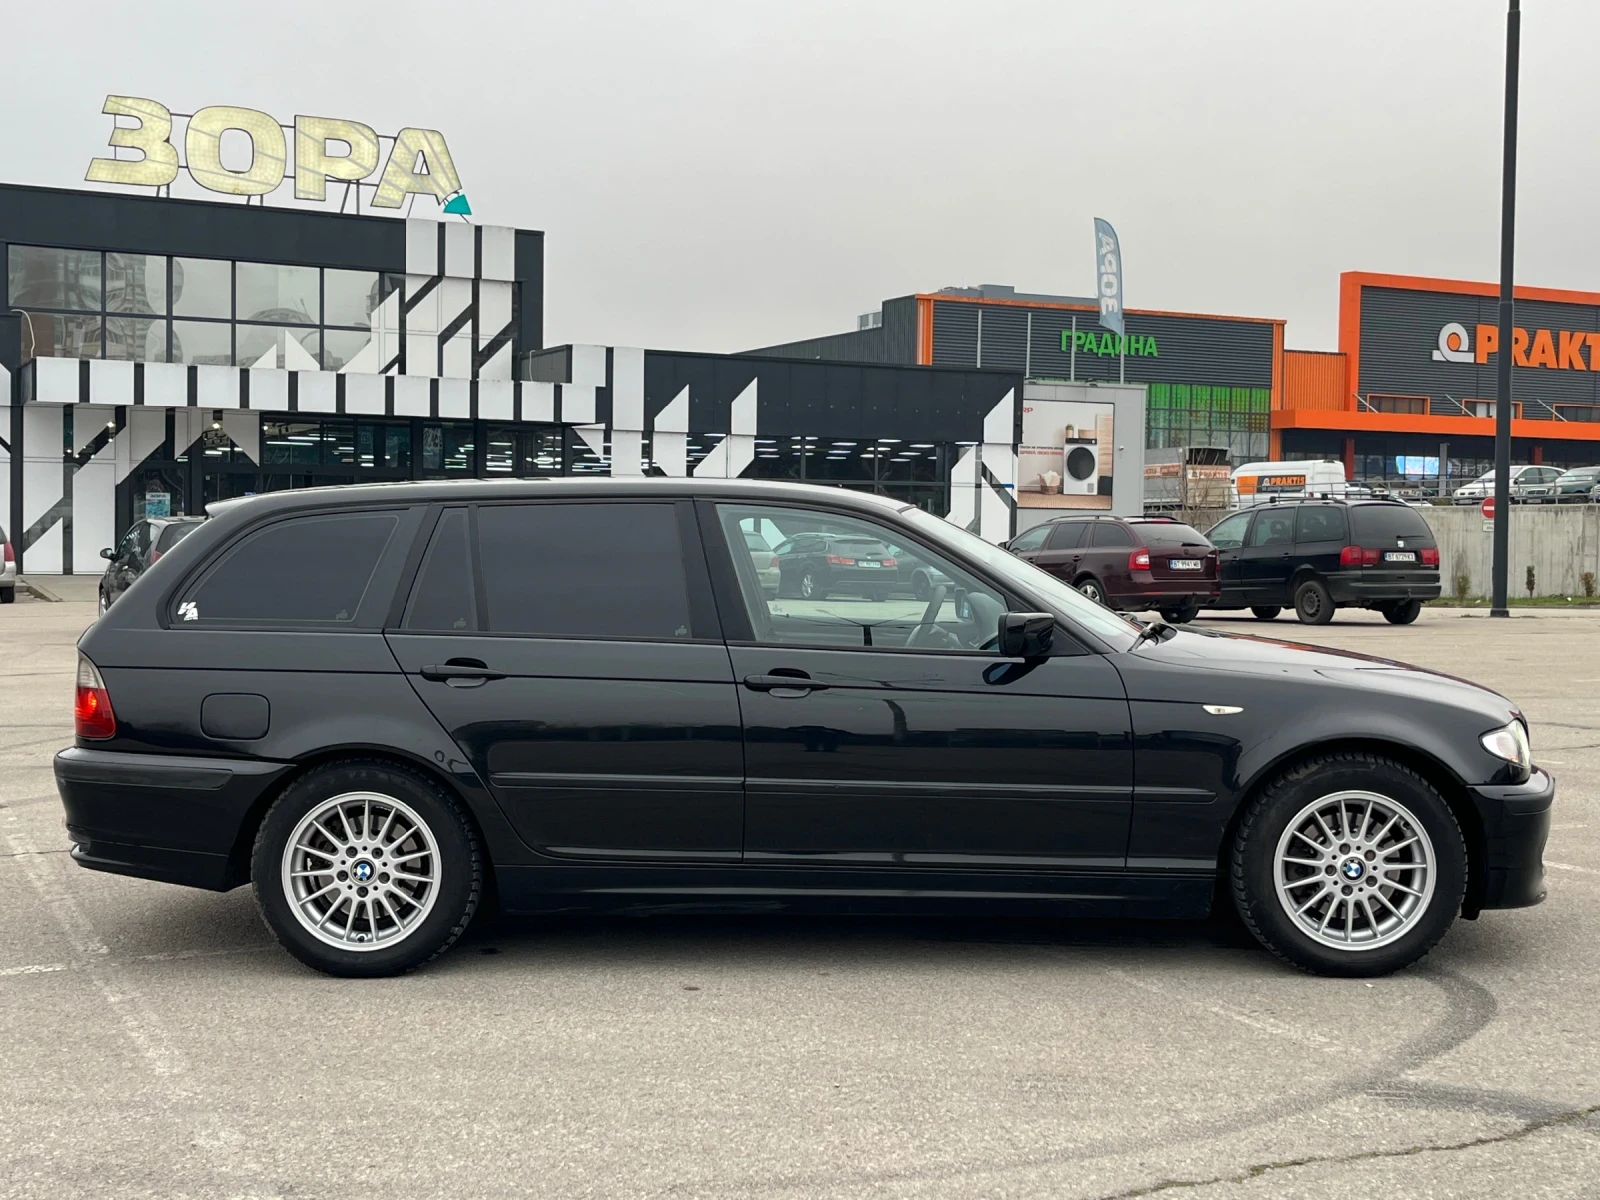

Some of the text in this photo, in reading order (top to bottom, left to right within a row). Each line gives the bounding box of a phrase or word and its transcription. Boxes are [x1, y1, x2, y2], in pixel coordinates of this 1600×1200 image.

[84, 94, 463, 208] ЗОРА
[1061, 330, 1158, 357] ГРАДИНА
[1270, 476, 1305, 486] PRAKTIS
